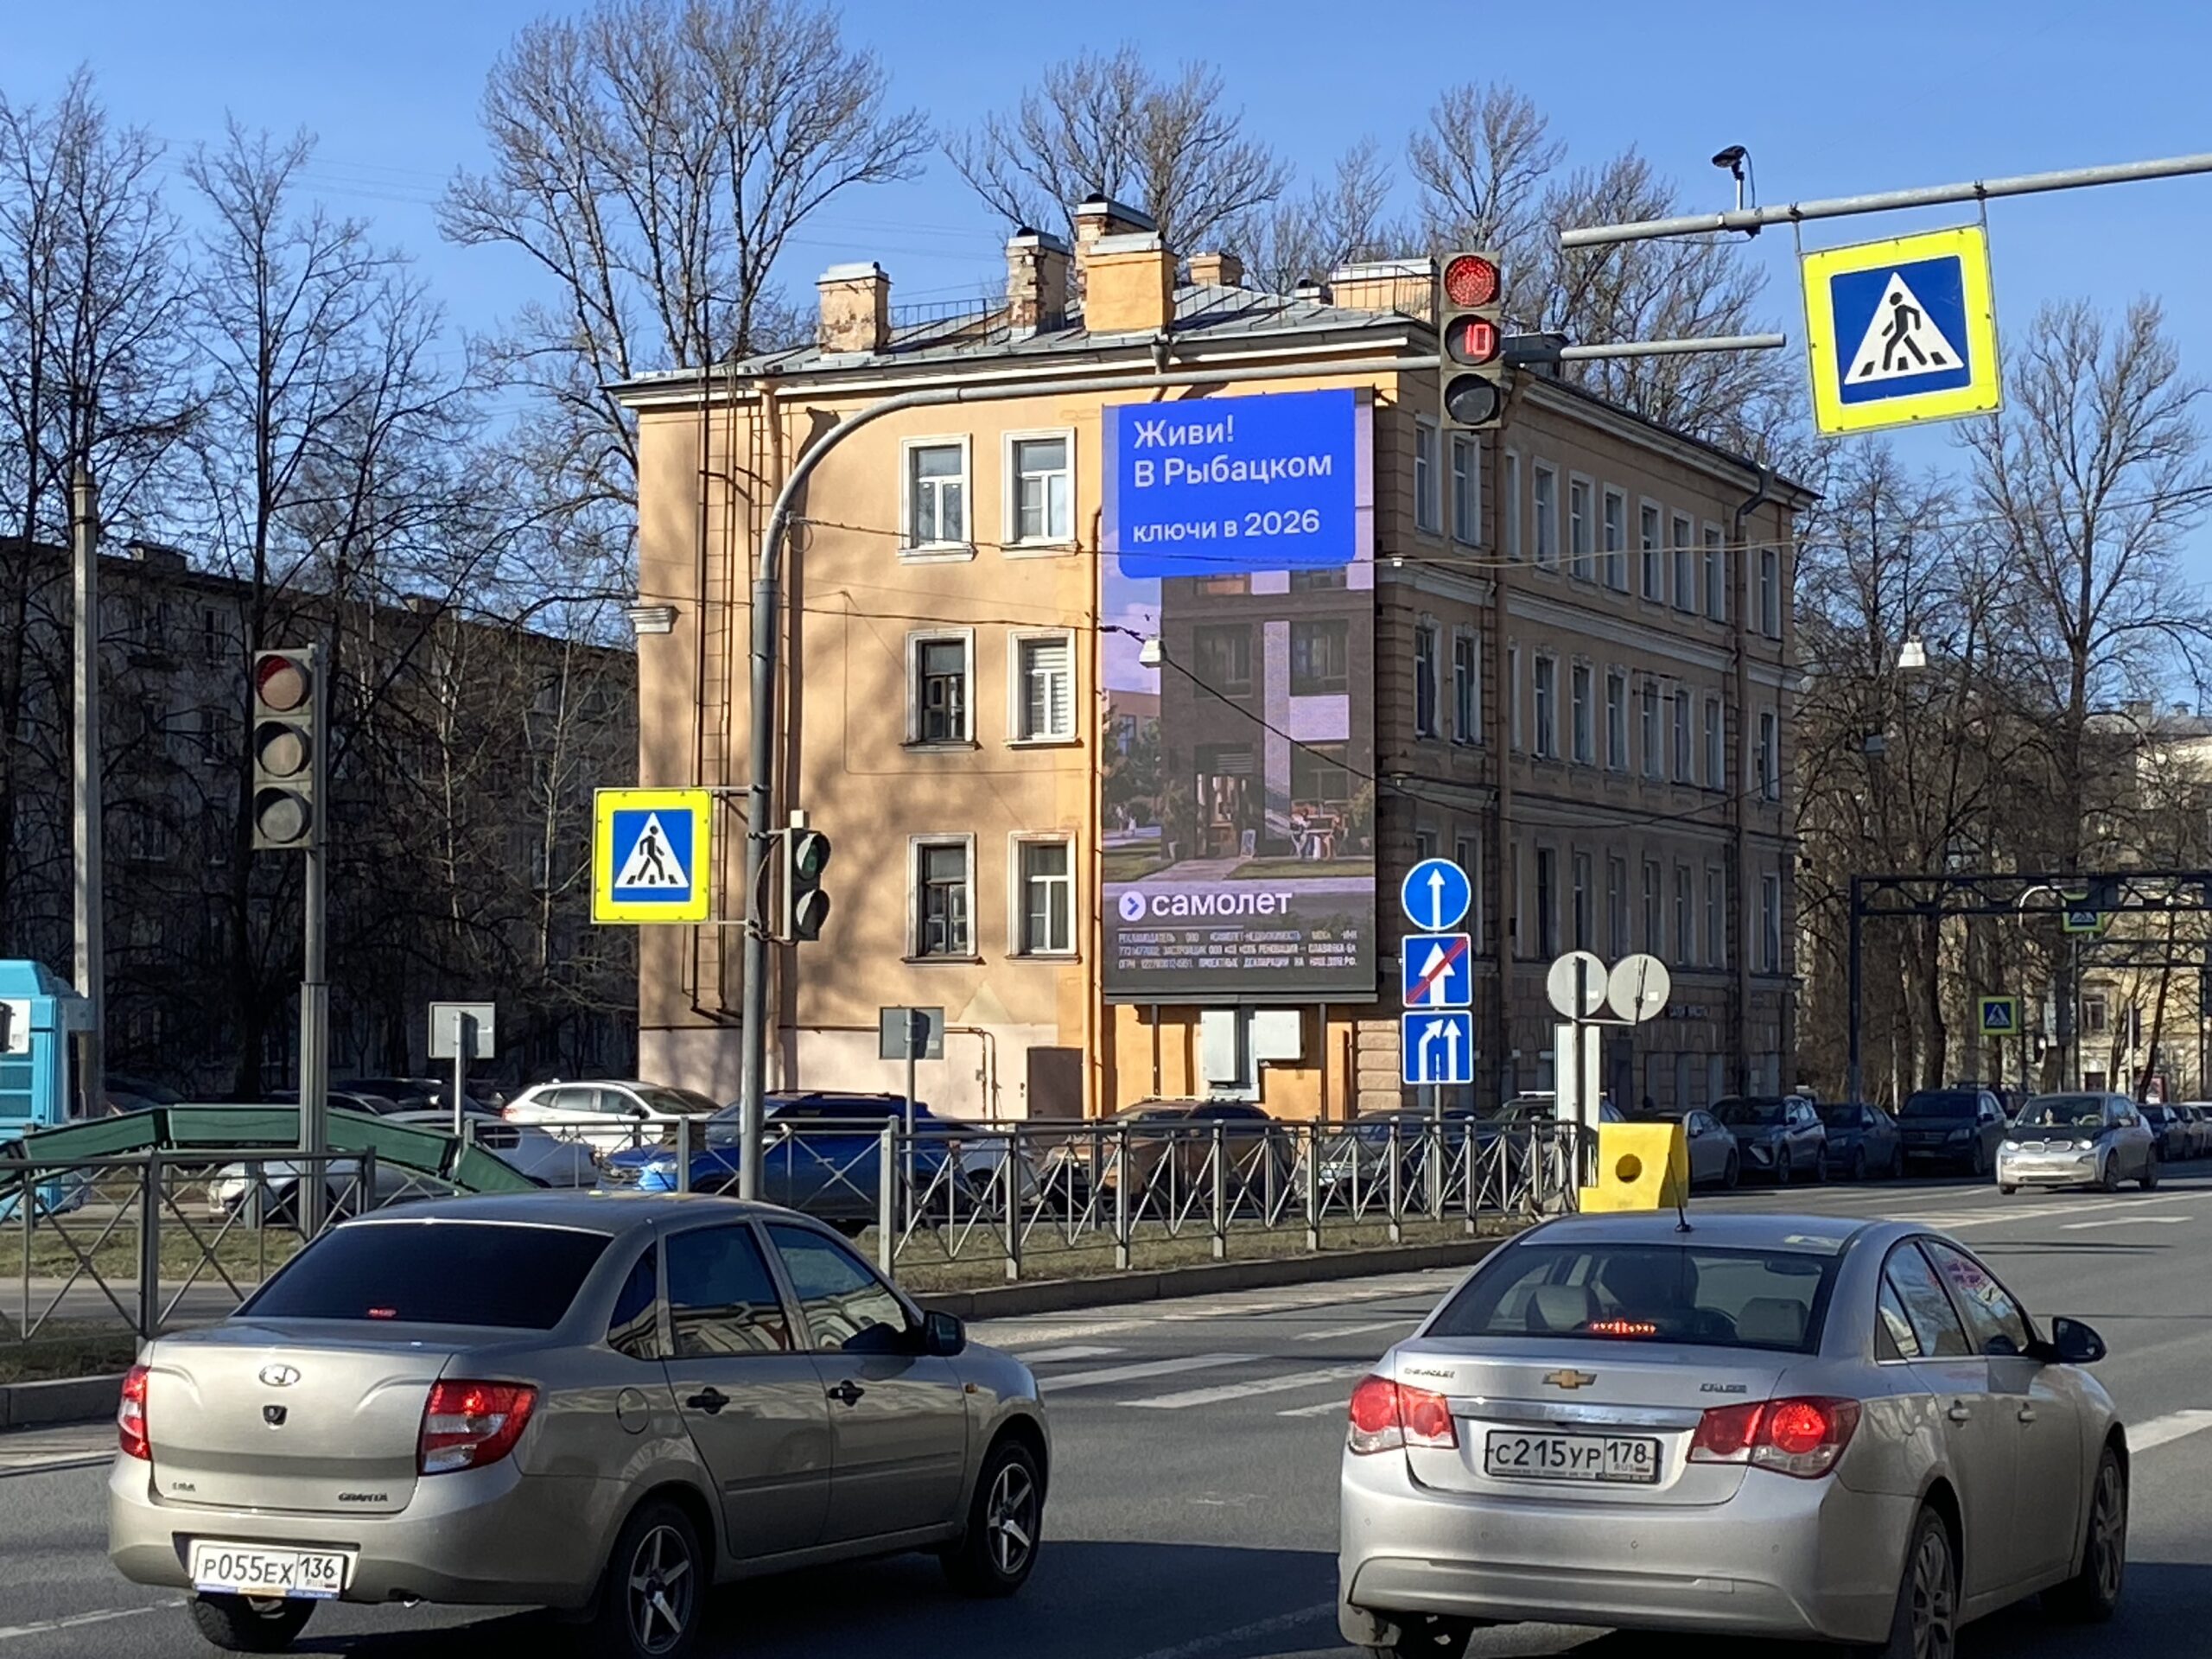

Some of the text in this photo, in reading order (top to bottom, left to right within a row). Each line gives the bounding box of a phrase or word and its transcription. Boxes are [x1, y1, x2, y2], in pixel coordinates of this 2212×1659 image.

[1465, 323, 1491, 356] 10
[1133, 414, 1235, 448] Живи!
[1134, 454, 1333, 487] В Рыбацком
[1133, 508, 1320, 543] ключи в 2026
[1151, 891, 1293, 917] самолет
[1606, 1441, 1648, 1464] 178
[299, 1556, 336, 1580] 136
